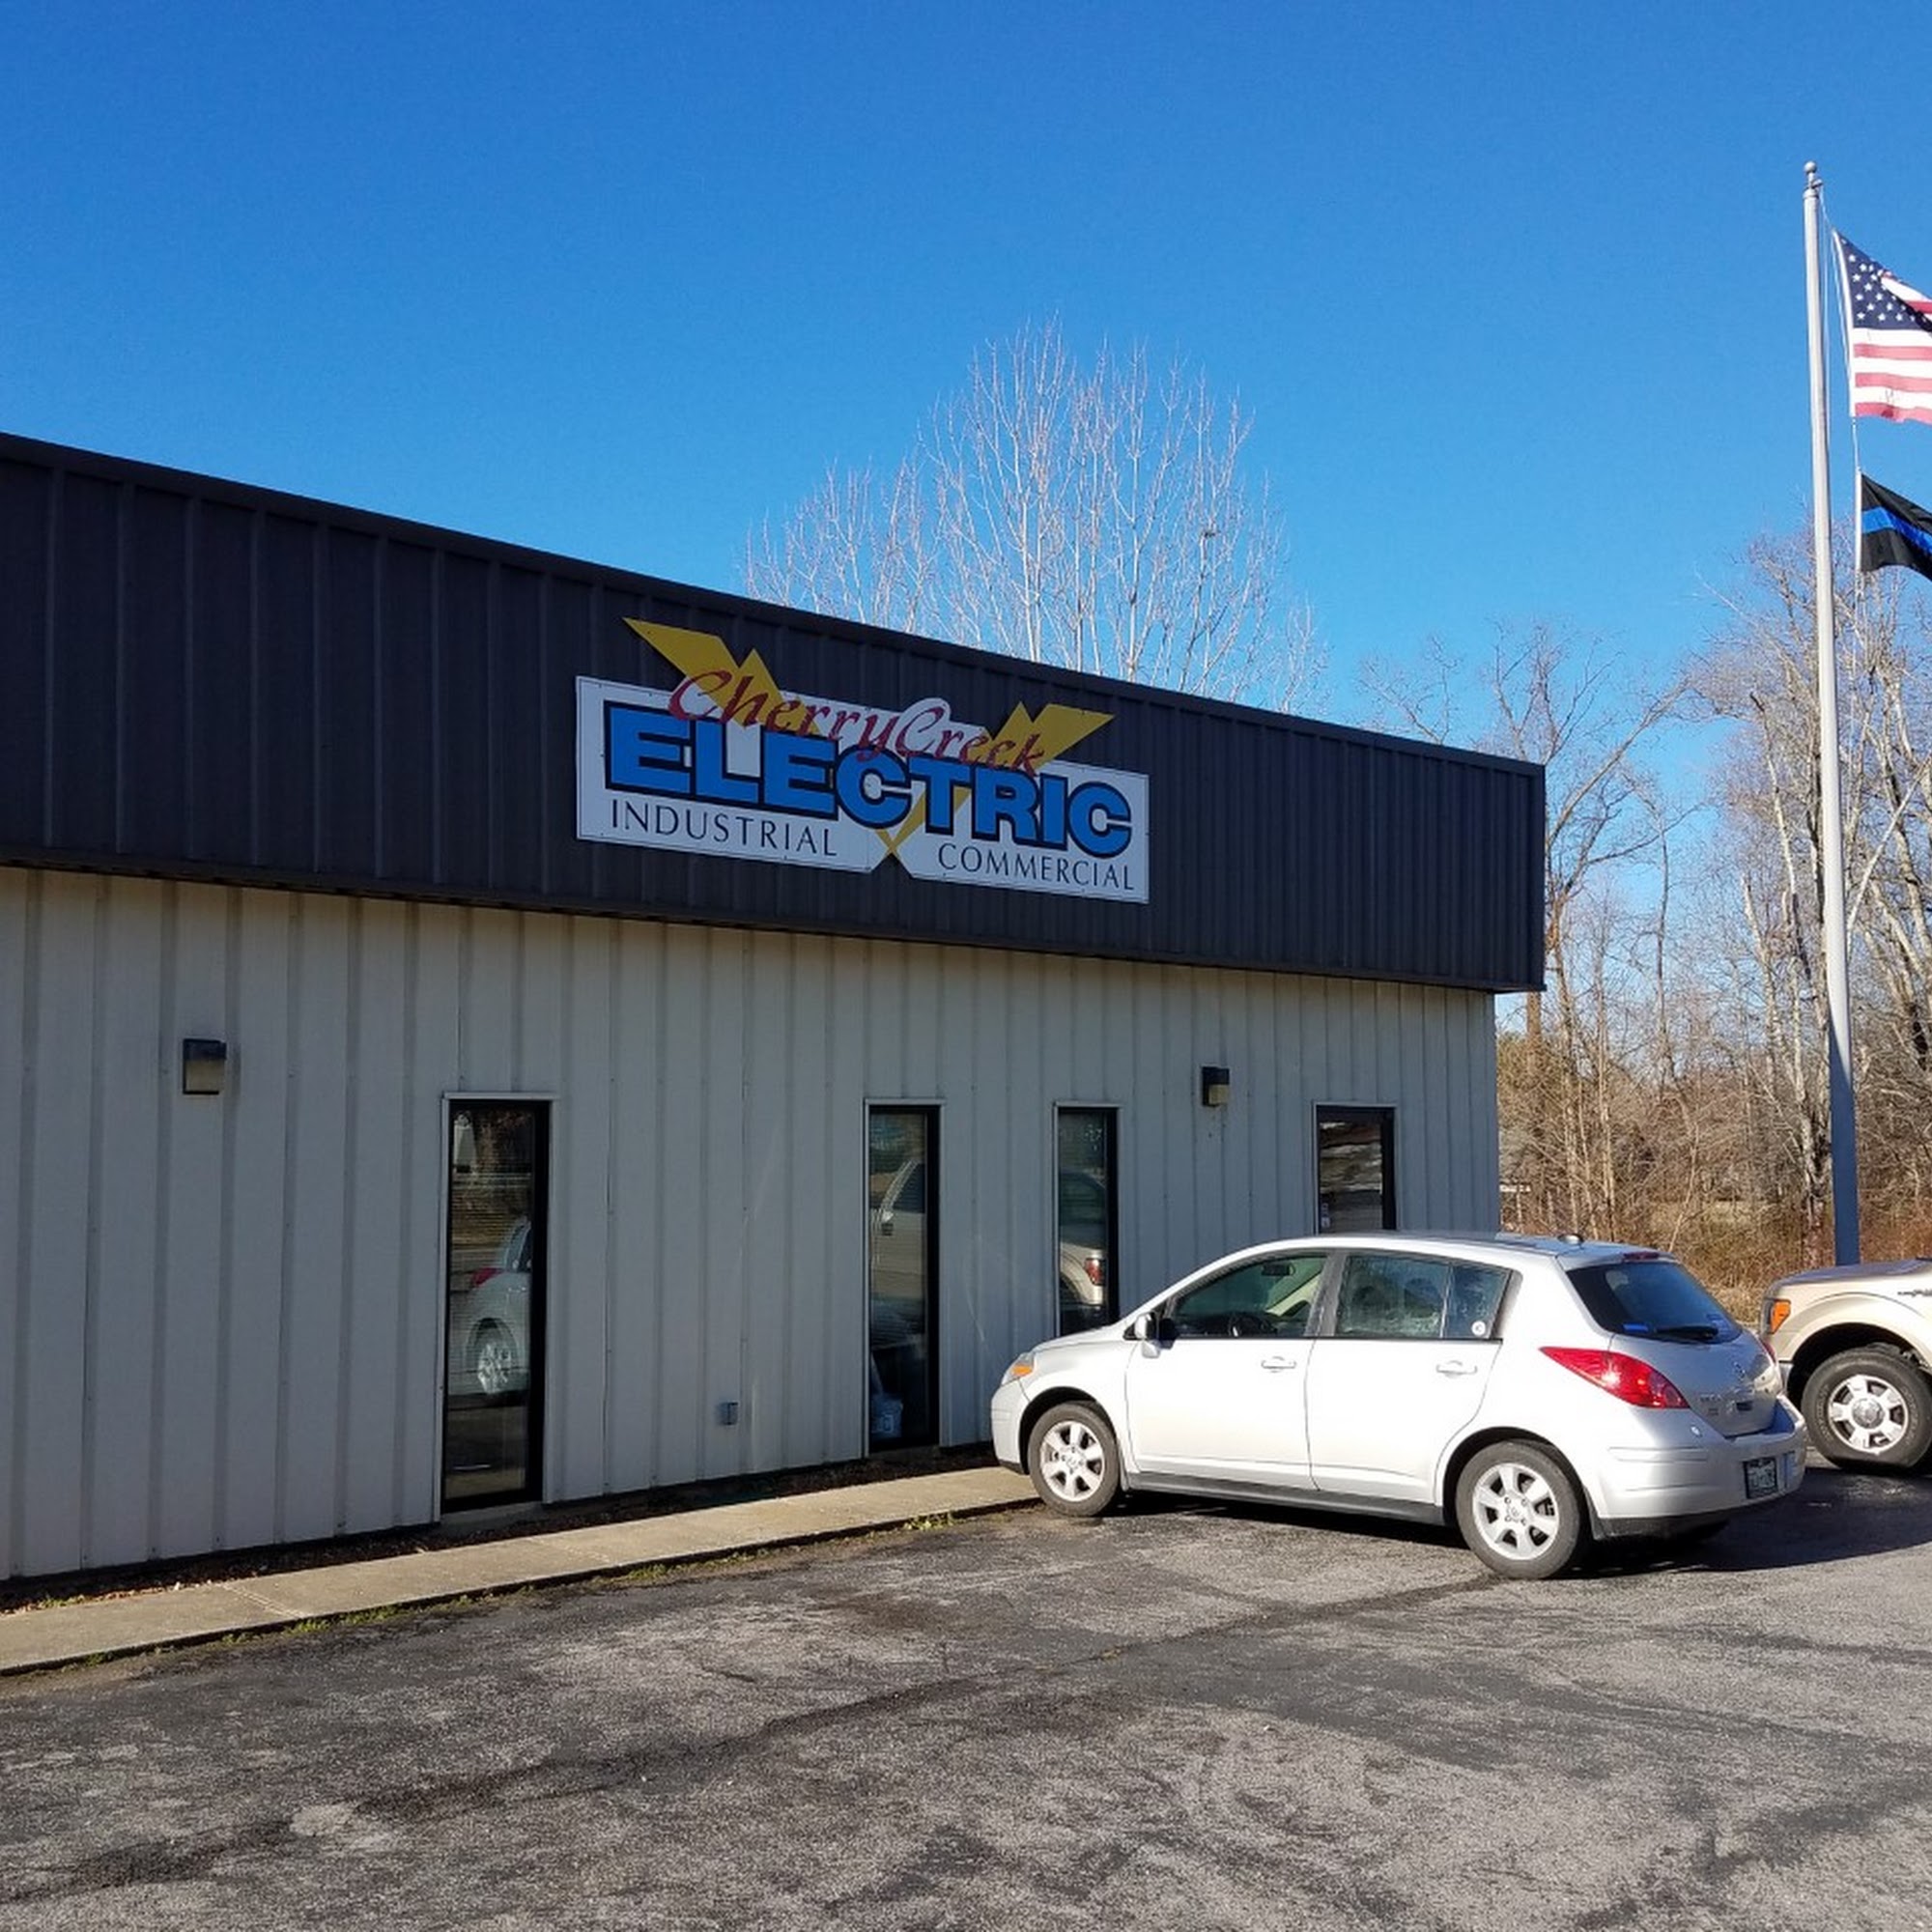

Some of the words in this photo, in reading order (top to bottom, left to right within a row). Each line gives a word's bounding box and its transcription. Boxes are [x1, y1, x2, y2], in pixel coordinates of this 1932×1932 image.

[604, 700, 1132, 858] ELECTRIC
[612, 799, 838, 857] INDUSTRIAL
[938, 843, 1135, 891] COMMERCIAL
